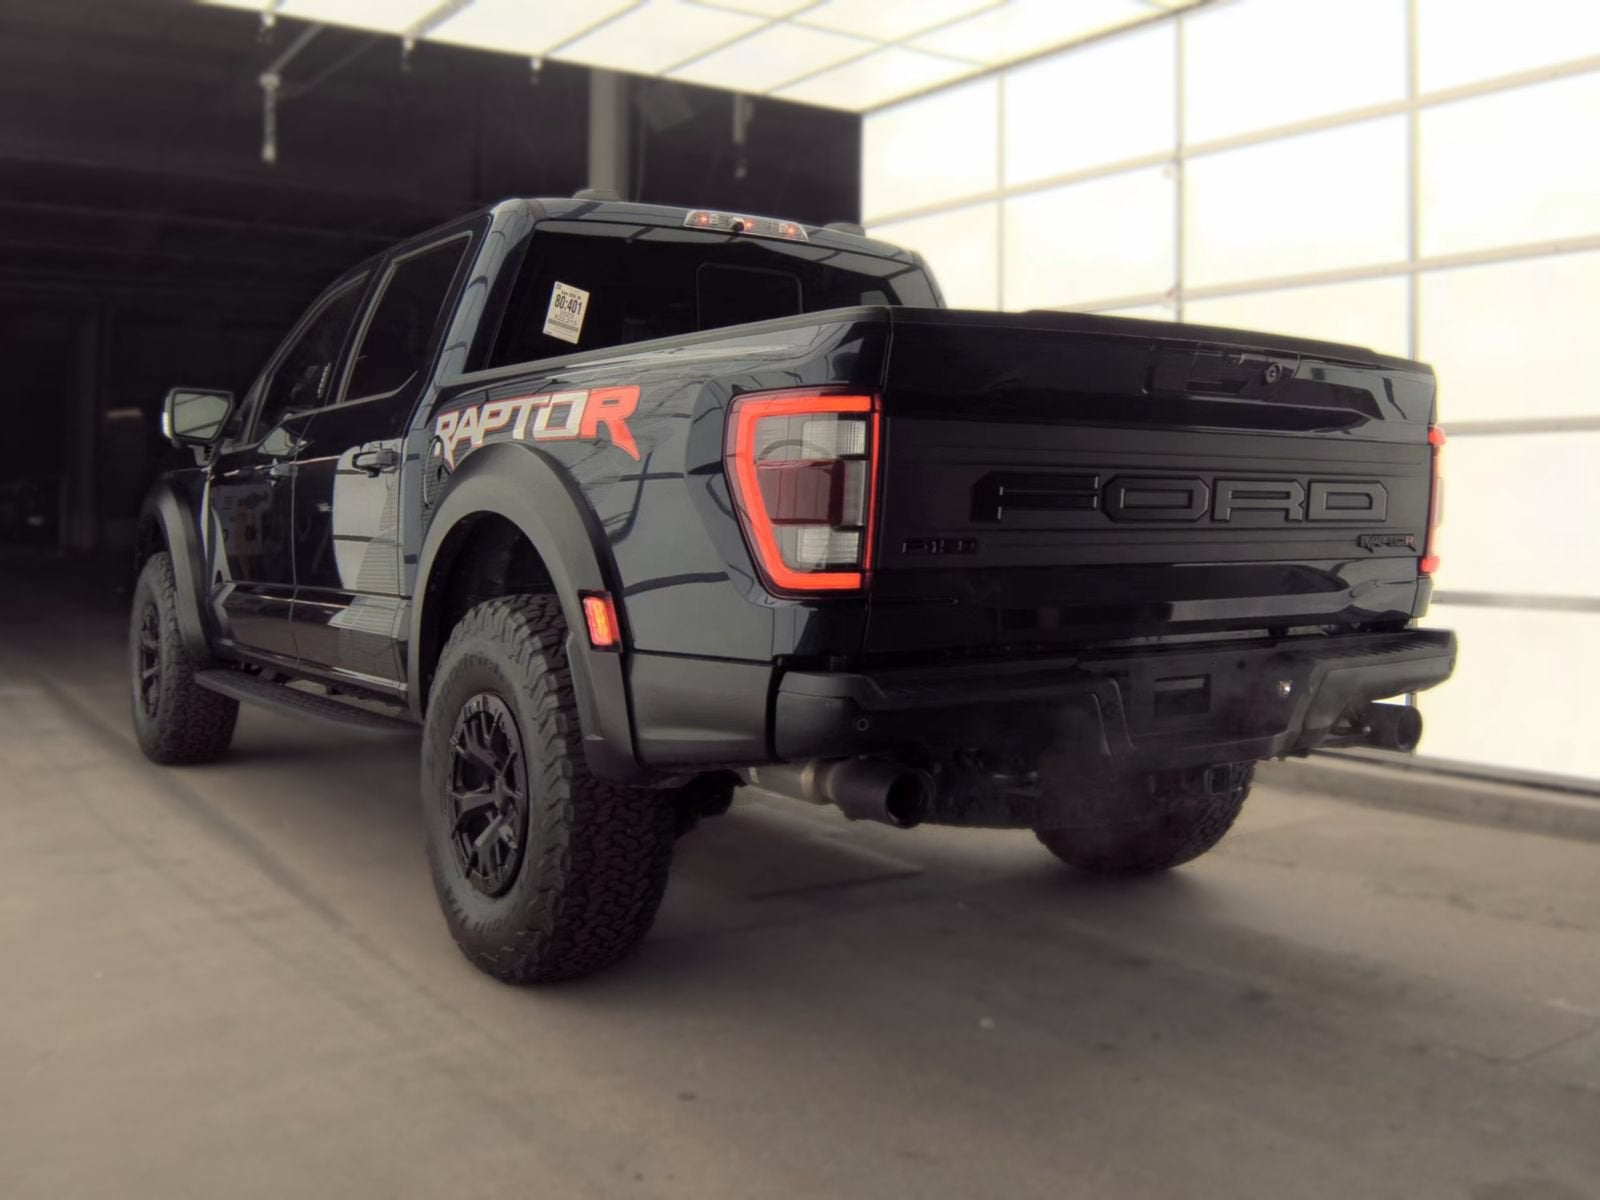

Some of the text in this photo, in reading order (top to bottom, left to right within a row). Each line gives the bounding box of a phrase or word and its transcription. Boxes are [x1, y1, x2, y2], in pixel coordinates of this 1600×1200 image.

[554, 294, 583, 315] 80:401
[434, 384, 641, 470] RAPTOR
[970, 472, 1389, 522] FORD
